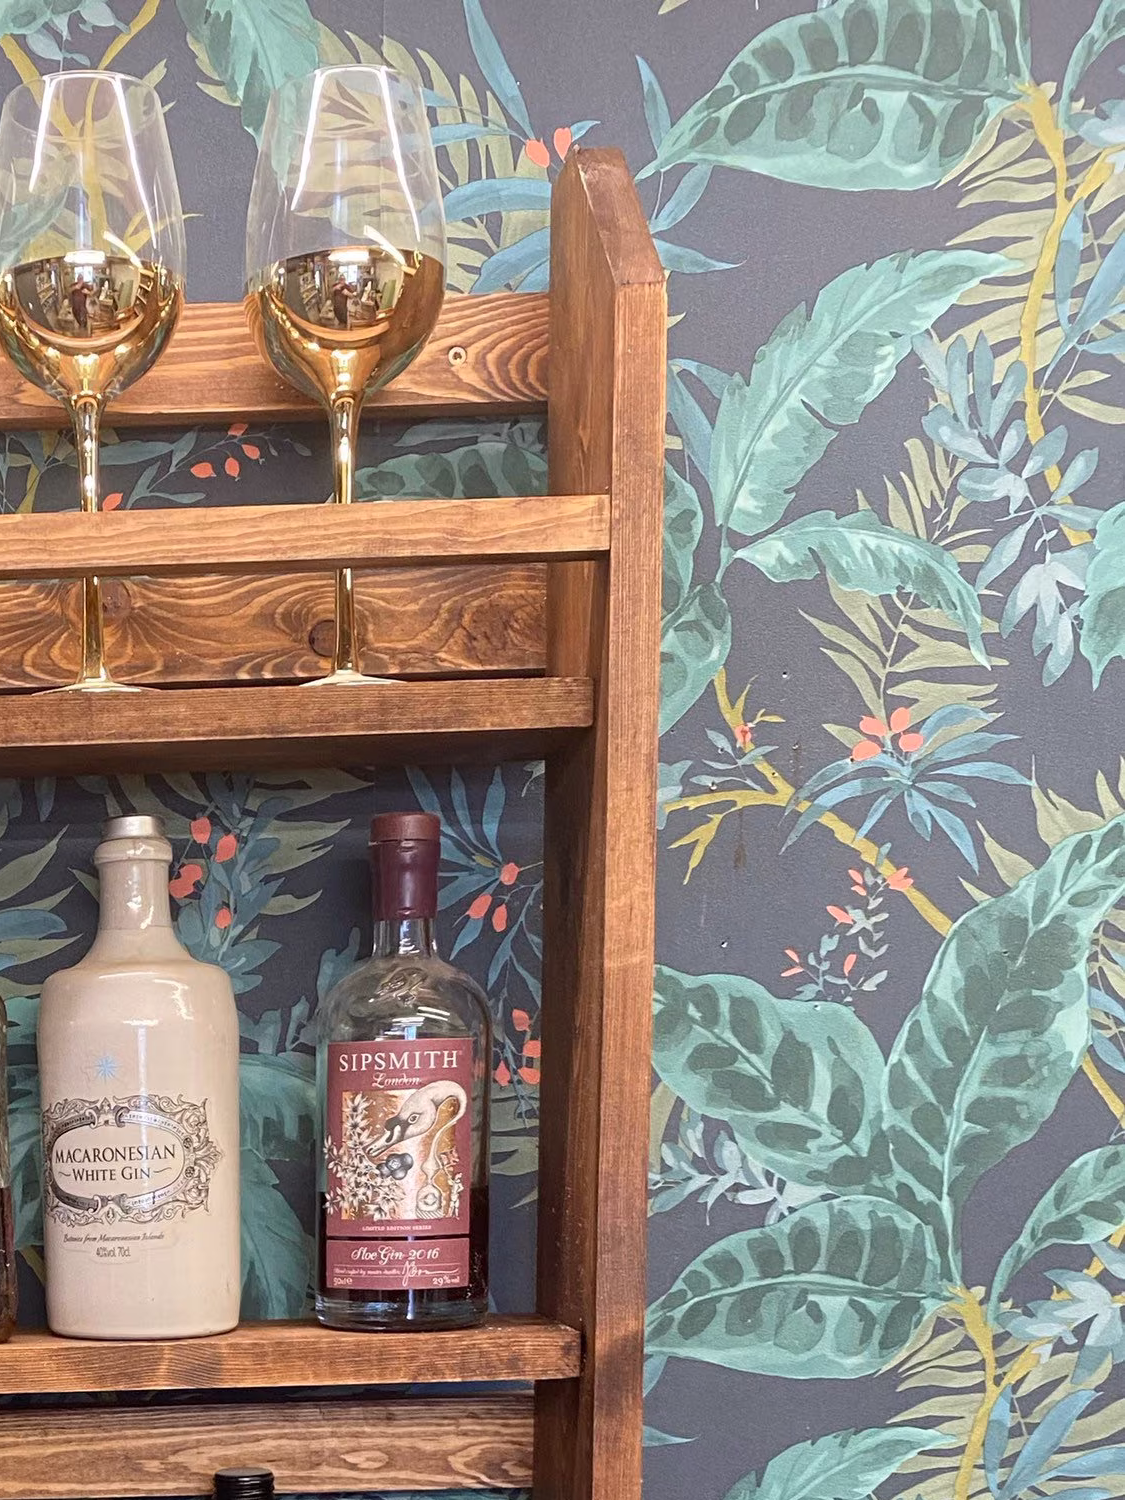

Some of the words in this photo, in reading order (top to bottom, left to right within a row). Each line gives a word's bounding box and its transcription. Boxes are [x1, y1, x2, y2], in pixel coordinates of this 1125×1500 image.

[339, 1050, 458, 1072] SIPSMITH
[372, 1072, 421, 1088] London
[55, 1144, 176, 1164] MACARONESIAN
[351, 1247, 378, 1260] Sloe
[377, 1245, 404, 1265] Gin
[407, 1247, 441, 1260] 2016
